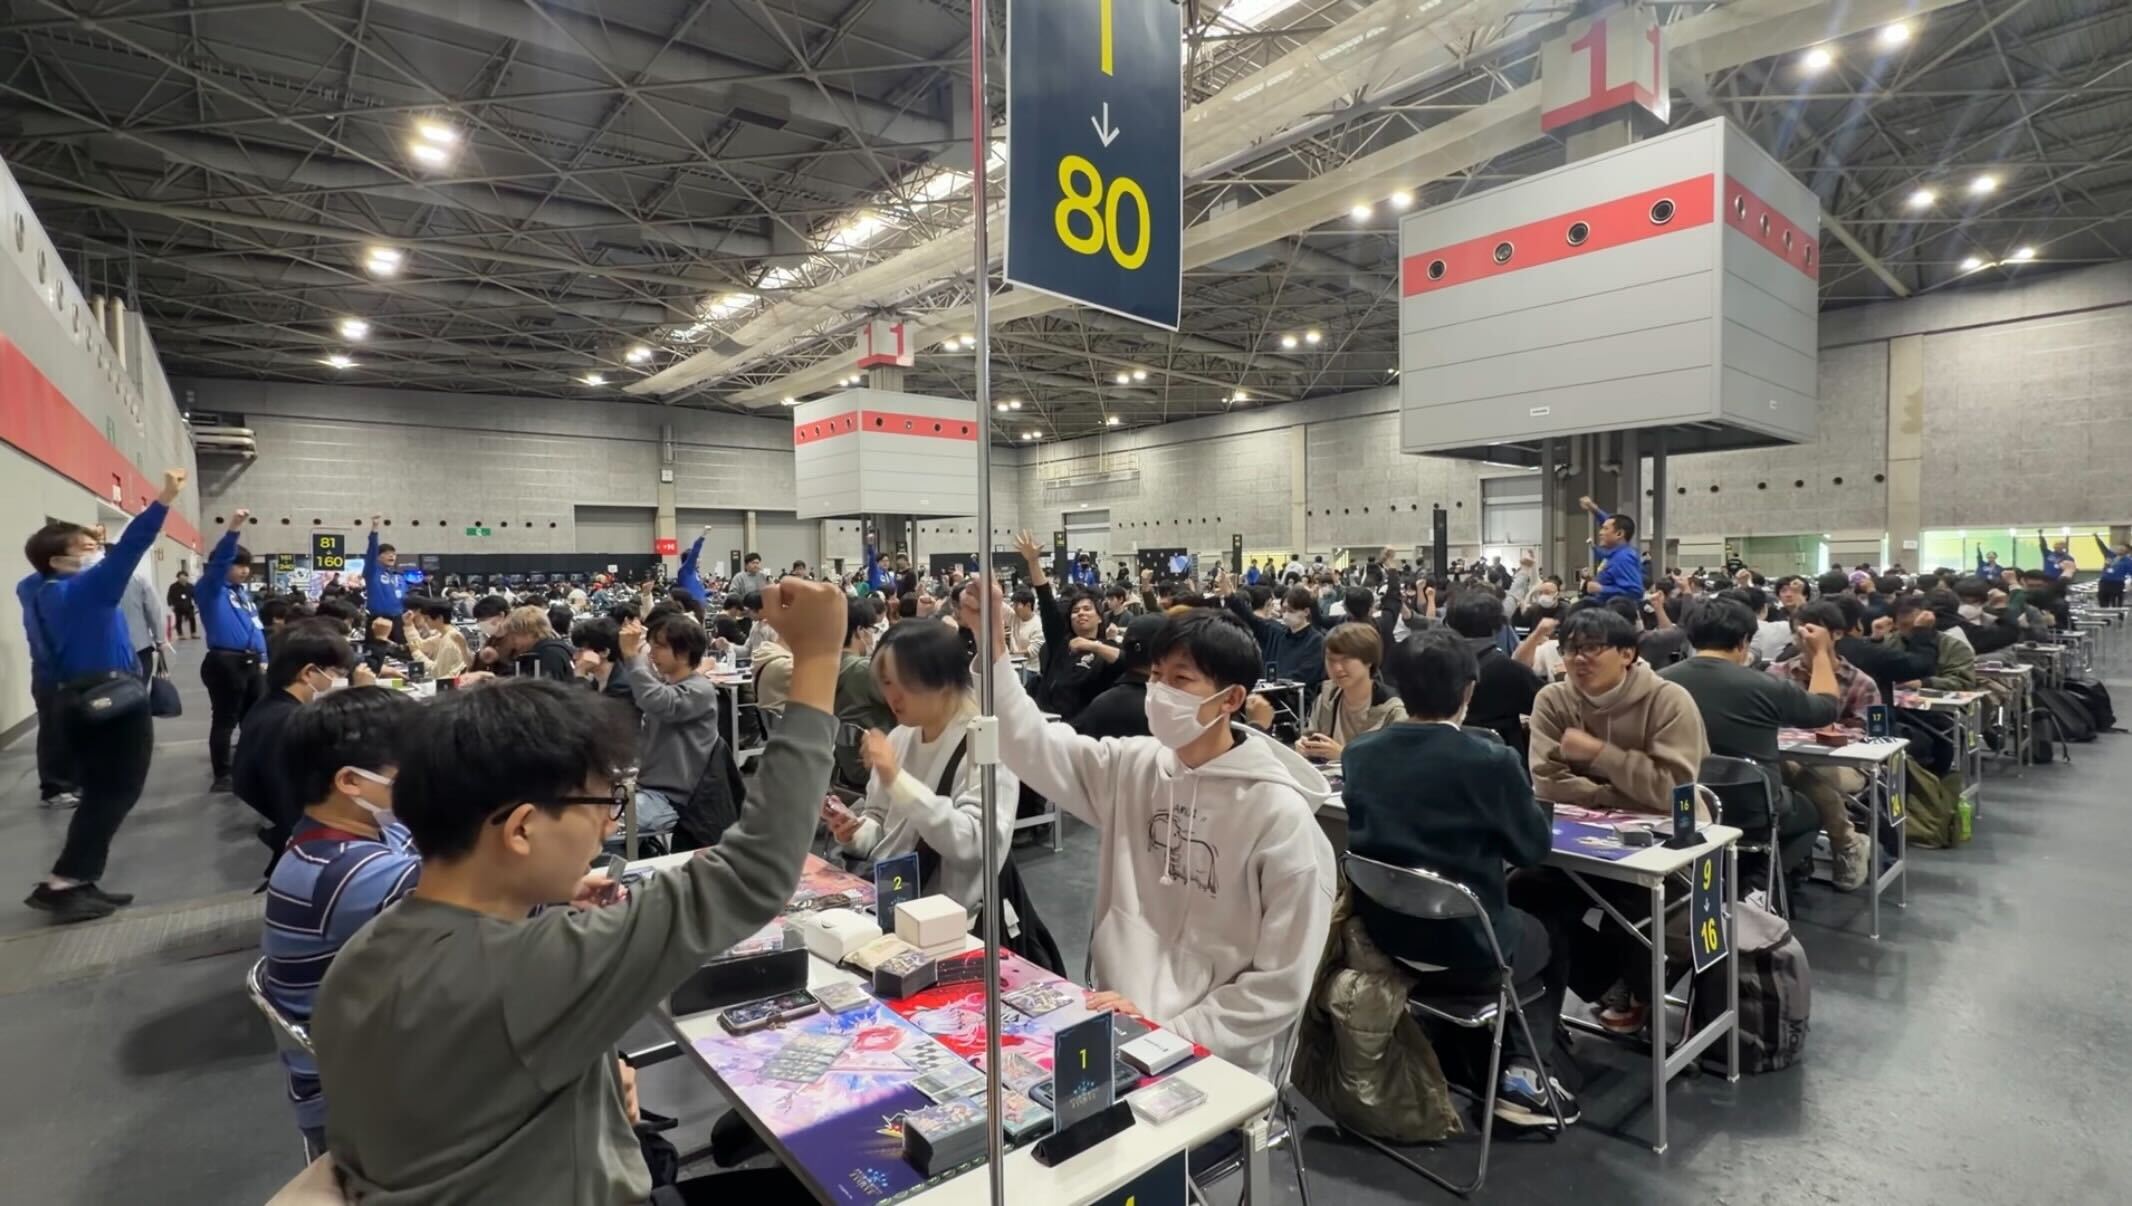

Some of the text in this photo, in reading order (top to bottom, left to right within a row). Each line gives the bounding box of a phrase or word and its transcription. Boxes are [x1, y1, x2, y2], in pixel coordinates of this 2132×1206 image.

[1570, 17, 1608, 100] 1
[1055, 154, 1151, 270] 80
[889, 322, 905, 358] 1
[320, 537, 336, 549] 81
[316, 556, 344, 568] 160
[1872, 713, 1882, 722] 17
[1679, 799, 1690, 812] 16
[893, 875, 903, 892] 2
[1702, 858, 1712, 891] 9
[1701, 917, 1718, 954] 16
[1079, 1048, 1088, 1070] 1
